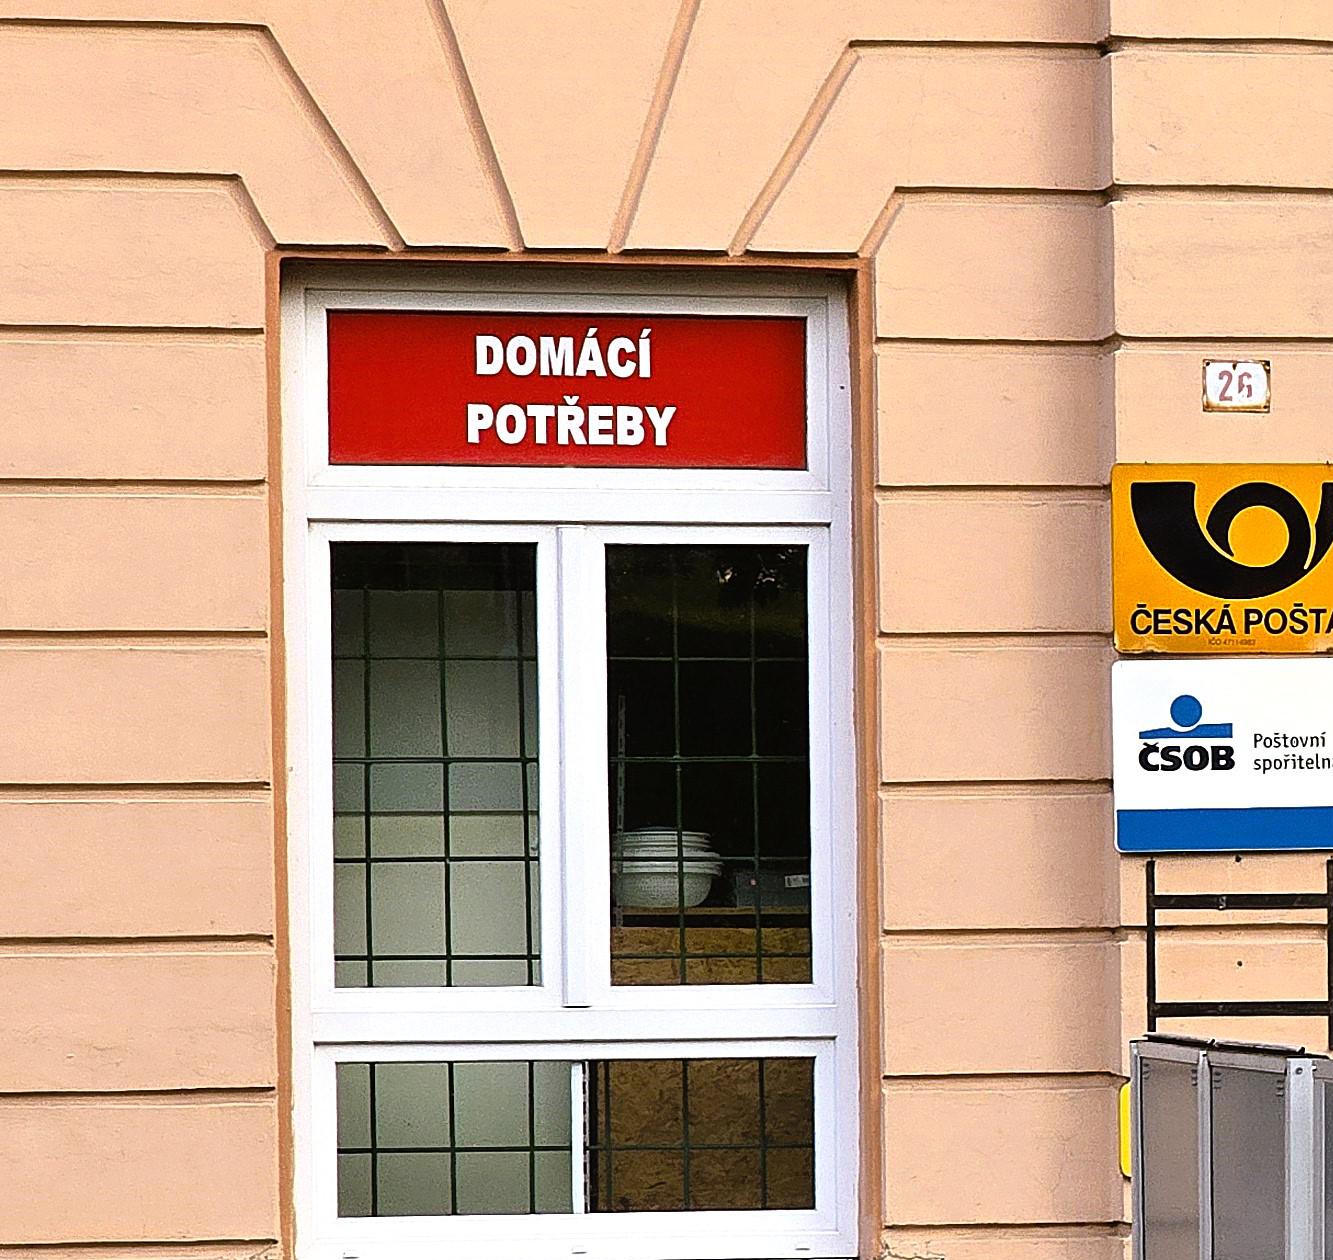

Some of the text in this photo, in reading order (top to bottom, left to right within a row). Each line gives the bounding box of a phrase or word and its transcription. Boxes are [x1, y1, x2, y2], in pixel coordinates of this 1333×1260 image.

[475, 327, 652, 379] DOMÁCÍ
[1218, 370, 1253, 402] 26
[467, 395, 678, 446] POTŘEBY
[1130, 603, 1237, 635] ČESKÁ
[1253, 731, 1327, 749] Poštovní
[1138, 741, 1236, 772] ČSOB
